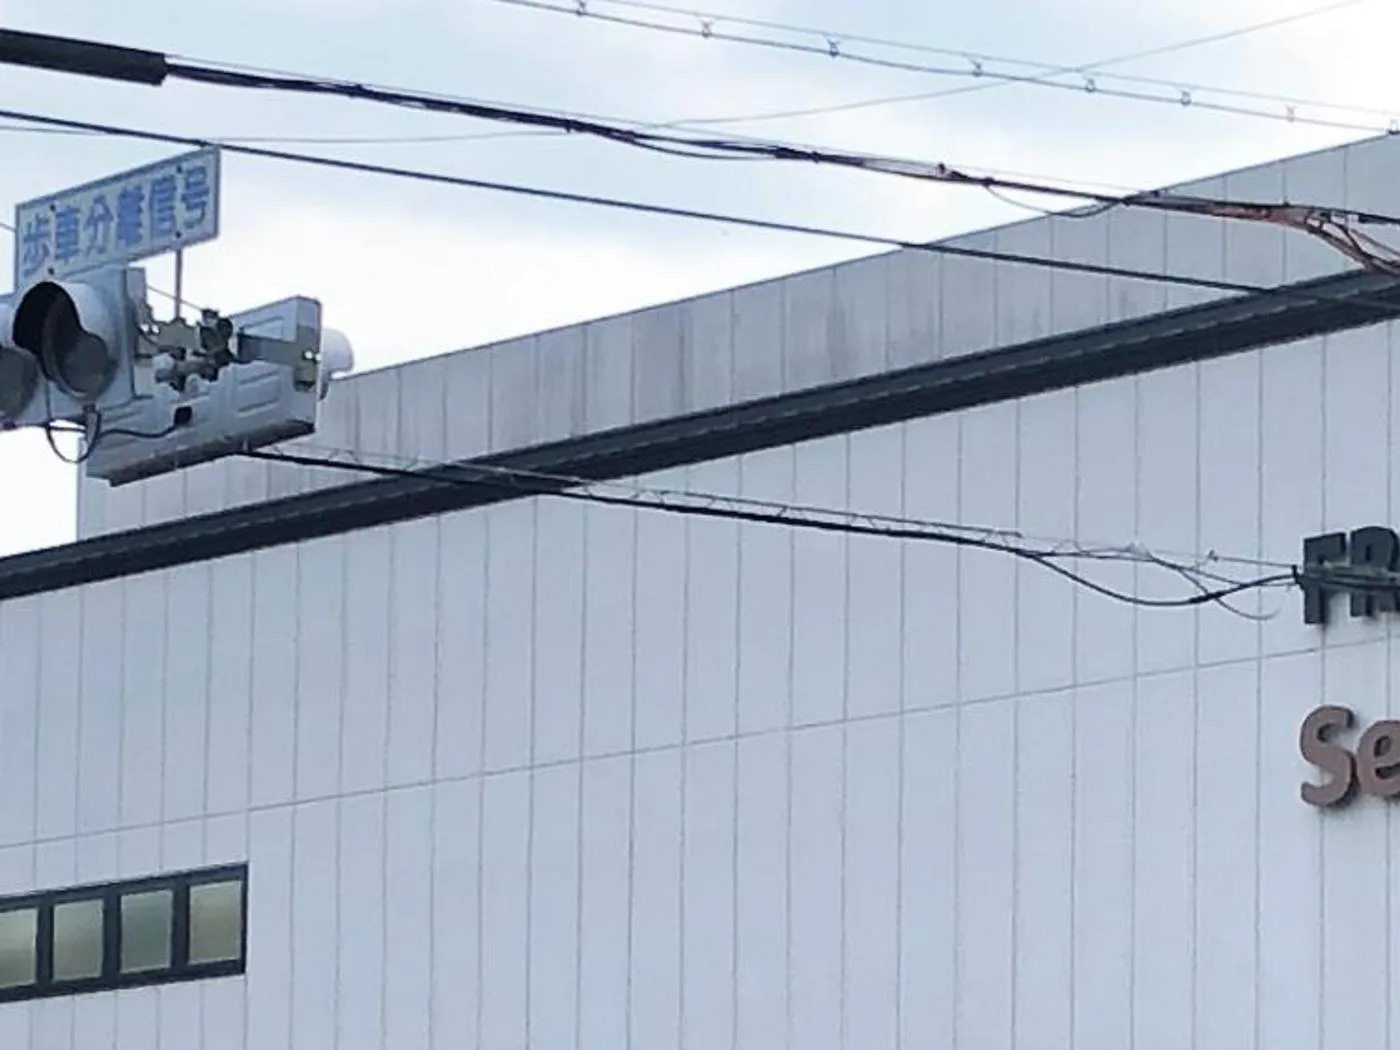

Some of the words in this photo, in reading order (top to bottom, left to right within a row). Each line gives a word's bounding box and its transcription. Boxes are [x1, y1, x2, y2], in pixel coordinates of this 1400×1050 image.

[23, 165, 210, 278] 歩車分離信号
